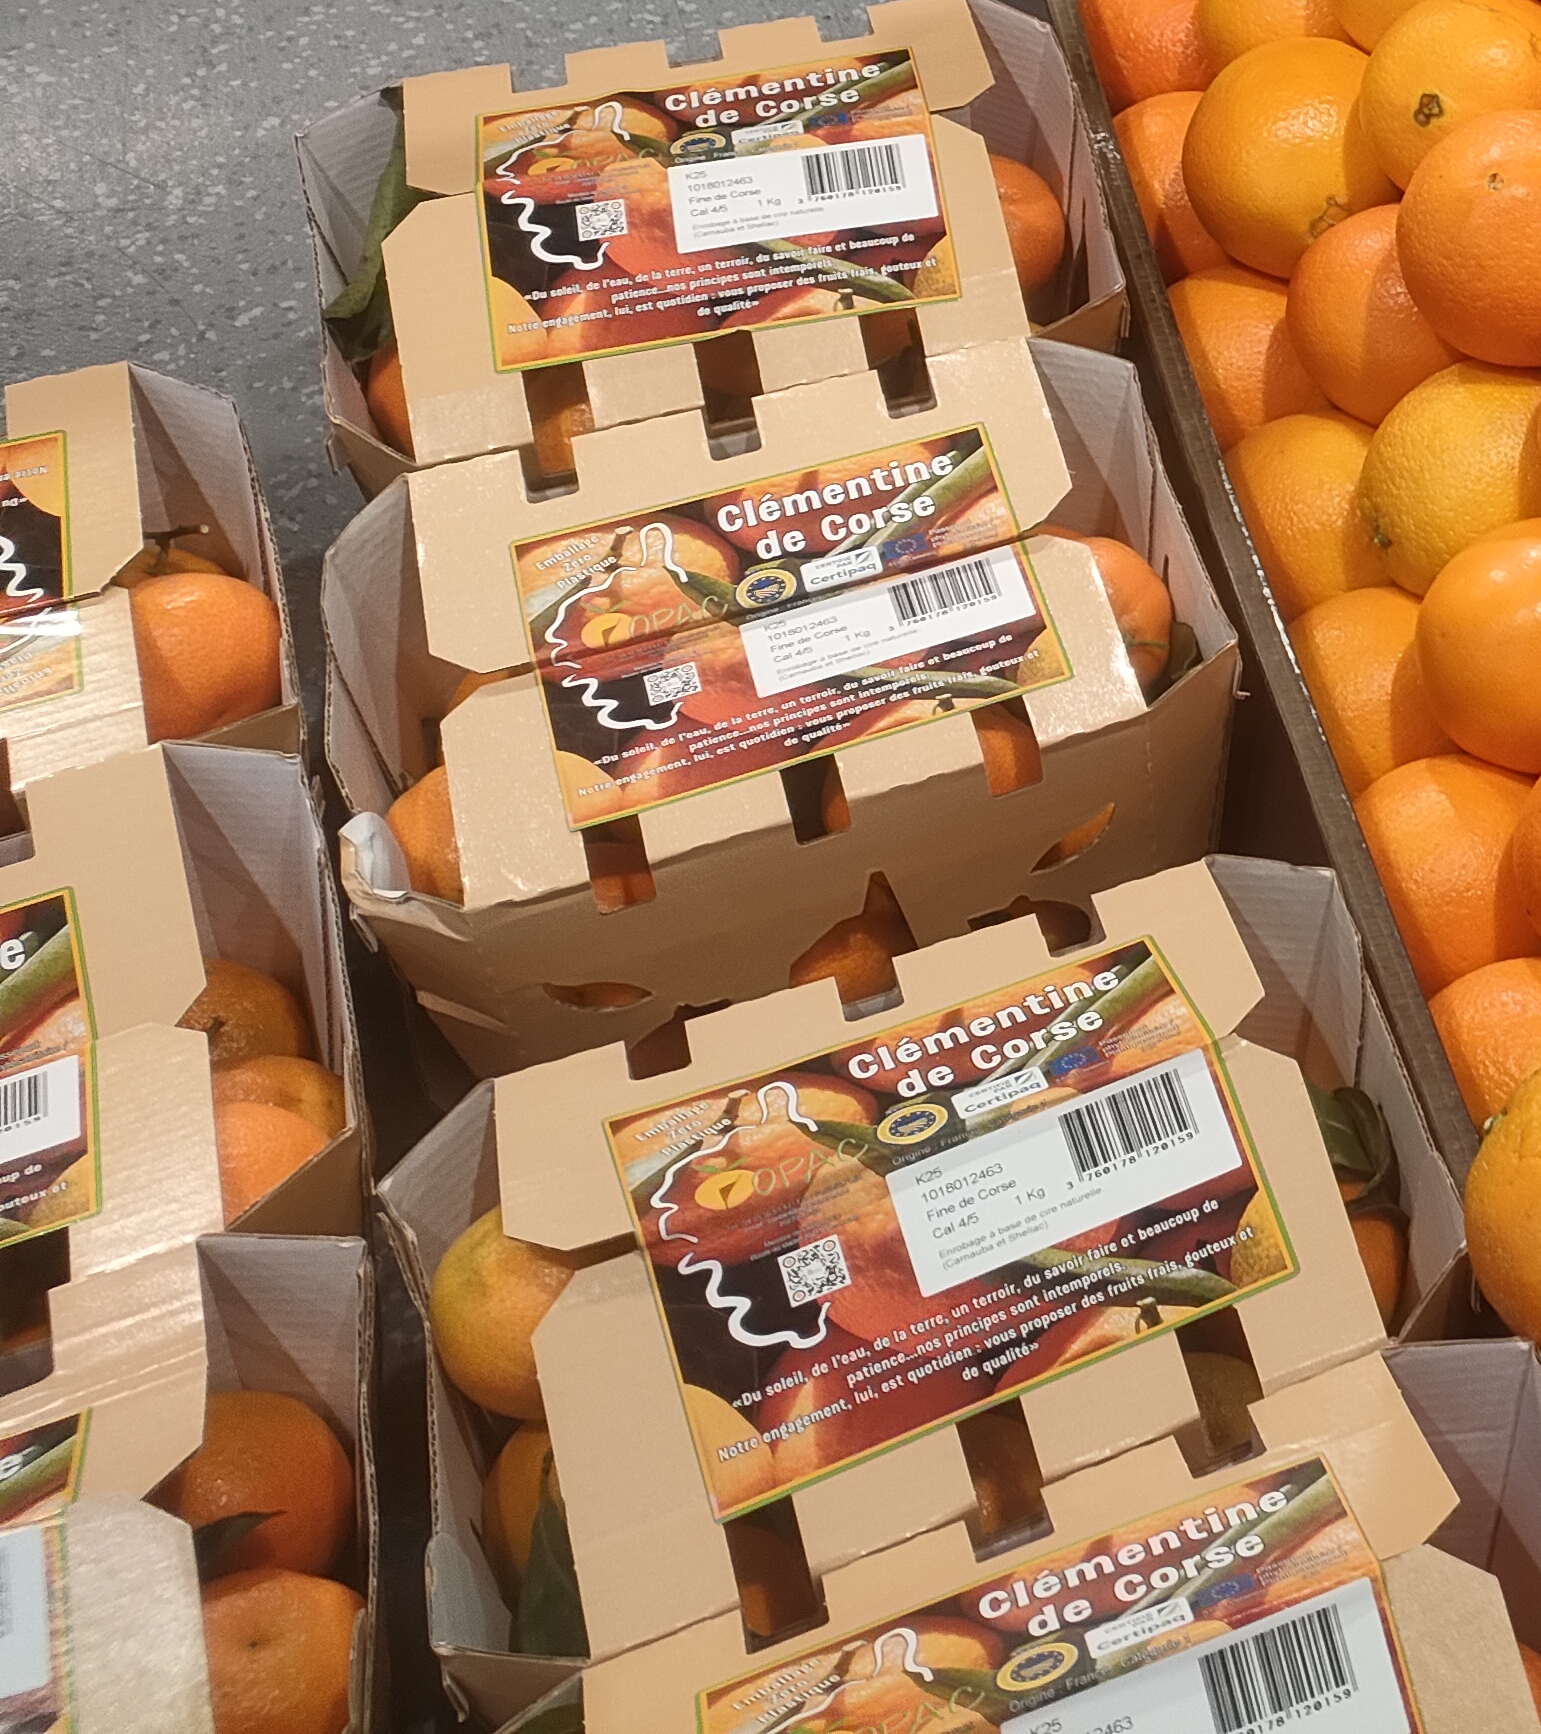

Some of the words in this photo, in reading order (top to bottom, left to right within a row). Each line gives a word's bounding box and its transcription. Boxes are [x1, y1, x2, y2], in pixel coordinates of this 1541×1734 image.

[663, 61, 882, 112] Clémentine
[694, 105, 740, 128] de
[754, 85, 861, 117] Corse
[717, 450, 953, 533] Clémentine
[756, 524, 806, 560] de
[820, 492, 937, 543] Corse
[844, 964, 1123, 1082] Clémentine
[892, 1056, 957, 1101] de
[967, 1005, 1106, 1073] Corse
[750, 1134, 870, 1200] OPAC
[914, 1166, 943, 1186] K25
[919, 1162, 1005, 1204] 1018012463
[925, 1200, 956, 1221] Fine
[956, 1193, 975, 1209] de
[976, 1176, 1018, 1201] Corse
[931, 1221, 955, 1240] Cal
[956, 1211, 980, 1229] 4/5
[1025, 1185, 1047, 1204] Kg
[809, 1359, 829, 1378] de
[871, 1334, 891, 1352] de
[891, 1326, 908, 1343] la
[950, 1303, 970, 1319] un
[1022, 1271, 1042, 1288] du
[1042, 1253, 1085, 1280] savoir
[1085, 1239, 1118, 1262] faire
[1118, 1232, 1136, 1248] et
[1136, 1205, 1202, 1243] beaucoup
[1200, 1196, 1220, 1214] de
[978, 1485, 1289, 1621] Clémentine
[1028, 1595, 1092, 1638] de
[1114, 1532, 1265, 1604] Corse
